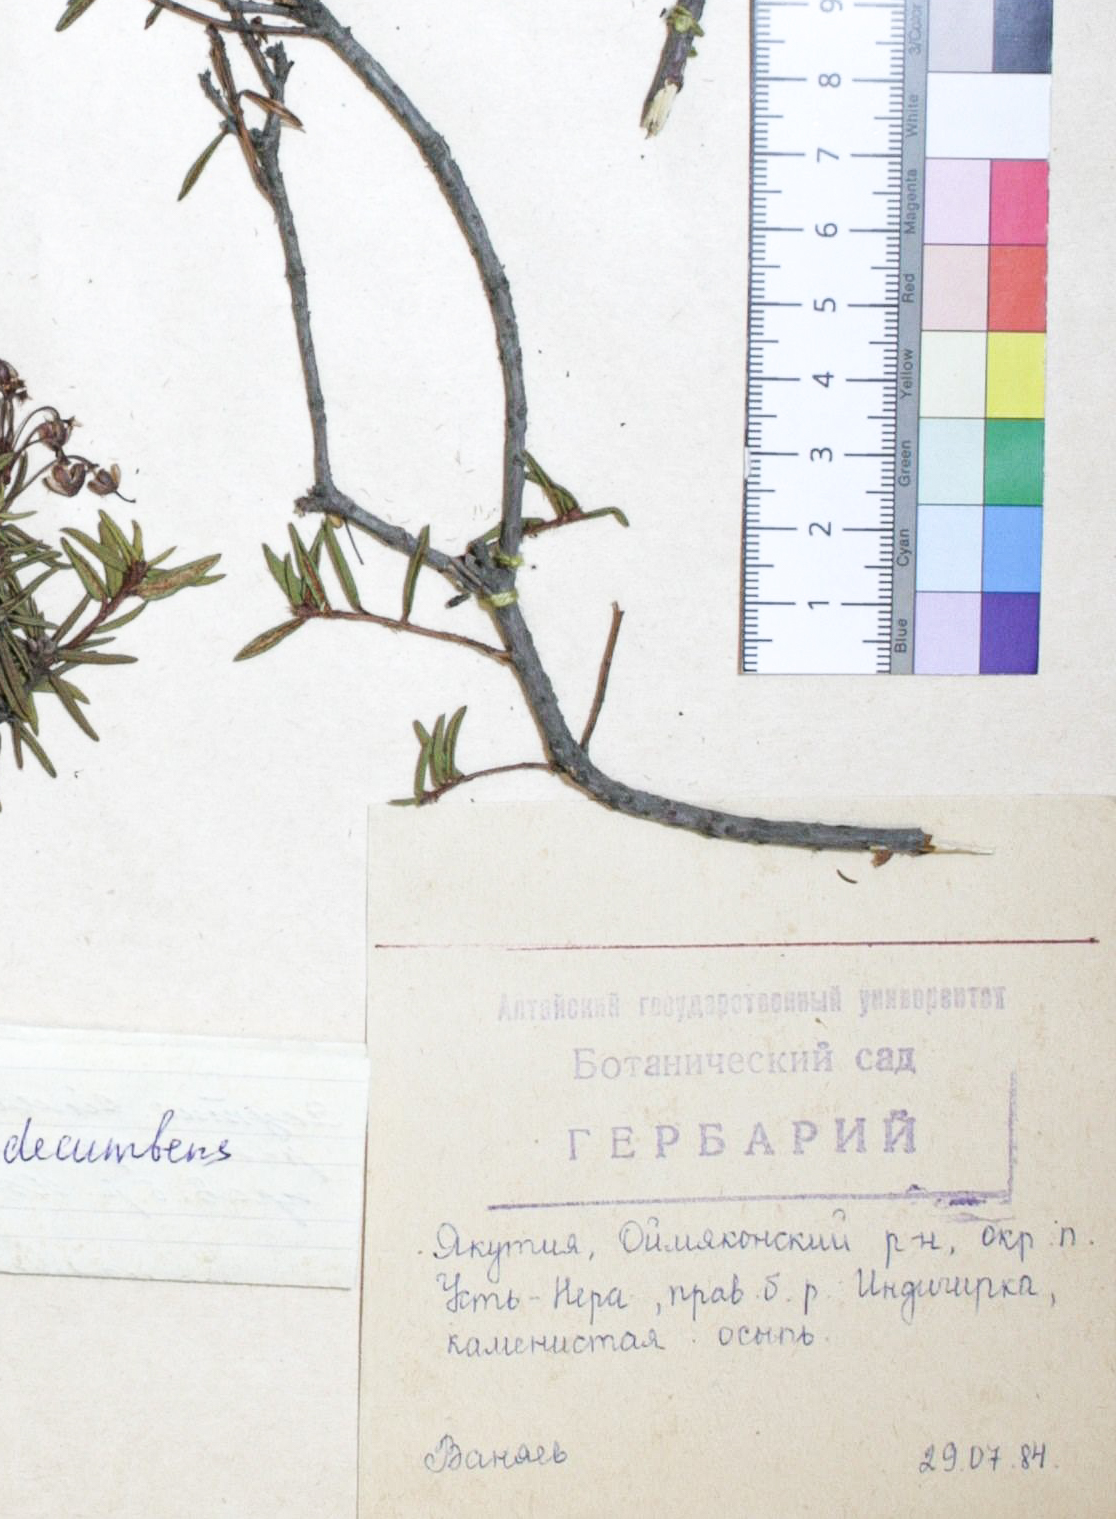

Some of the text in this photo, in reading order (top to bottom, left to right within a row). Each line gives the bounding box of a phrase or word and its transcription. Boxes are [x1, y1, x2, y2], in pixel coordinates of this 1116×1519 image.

[818, 72, 842, 89] 8
[906, 92, 920, 138] White
[816, 147, 840, 164] 7
[904, 167, 920, 235] Magenta
[814, 222, 839, 238] 6
[813, 296, 837, 313] 5
[902, 273, 916, 303] Red
[811, 371, 835, 388] 4
[900, 348, 915, 400] Yellow
[809, 446, 833, 463] 3
[898, 439, 912, 487] Green
[808, 521, 832, 538] 2
[896, 528, 912, 567] Cyan
[807, 599, 830, 610] 1
[894, 617, 908, 654] Blue
[573, 1040, 917, 1081] Ботанический сад
[3, 1108, 233, 1167] decumbens
[567, 1108, 917, 1161] ГЕРБАРИЙ
